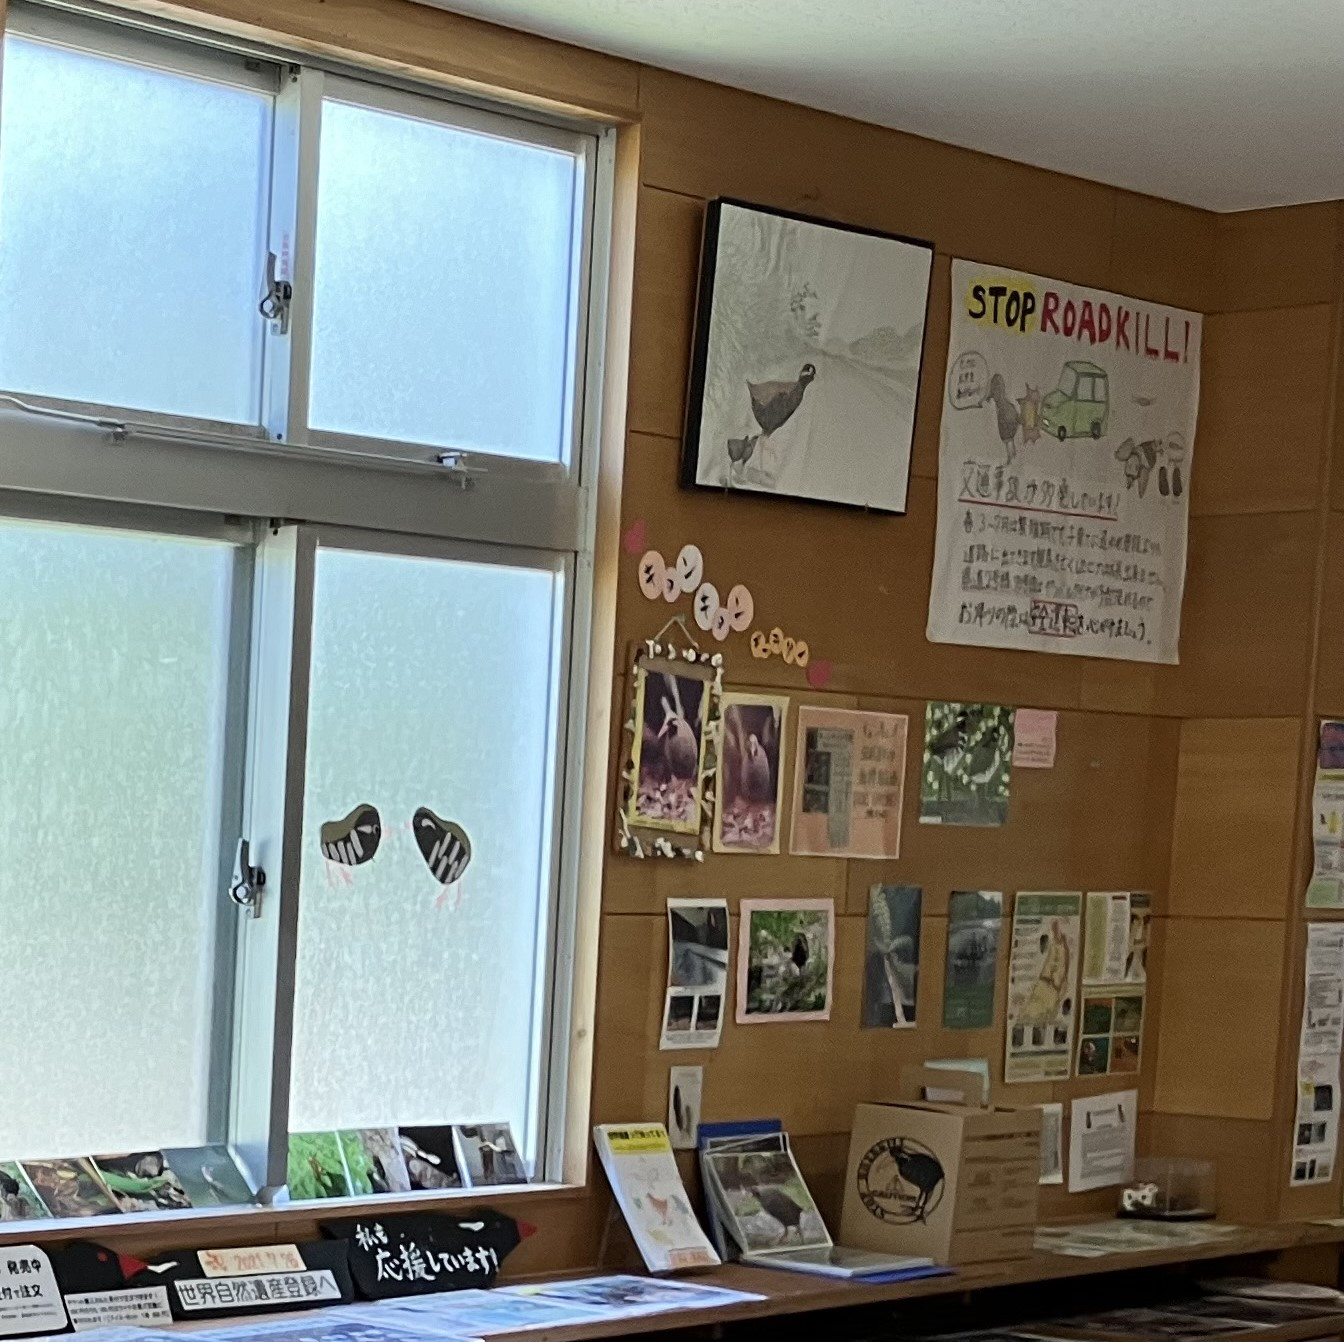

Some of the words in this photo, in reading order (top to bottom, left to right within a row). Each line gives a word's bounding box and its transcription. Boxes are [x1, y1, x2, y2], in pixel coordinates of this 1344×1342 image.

[968, 284, 1036, 333] STOP
[1040, 291, 1191, 364] ROADKILL!
[356, 1223, 389, 1251] 私も
[376, 1241, 500, 1282] 応援しています!
[178, 1273, 338, 1306] 世界自然遺産登録へ
